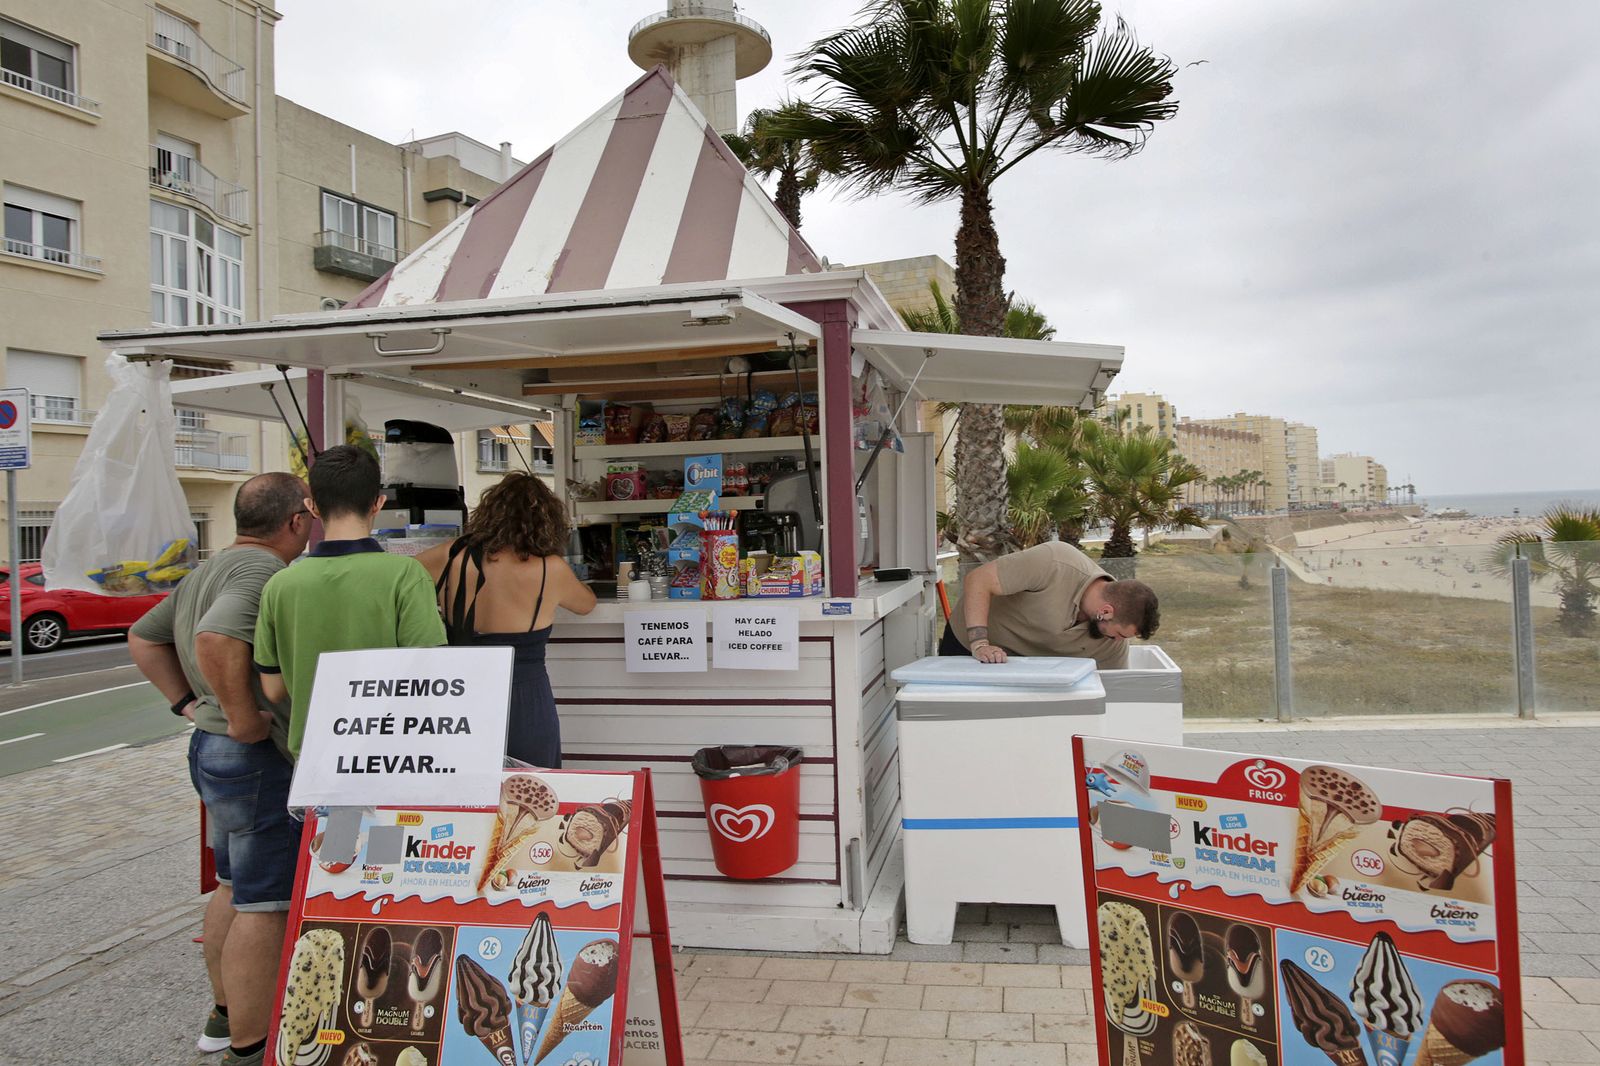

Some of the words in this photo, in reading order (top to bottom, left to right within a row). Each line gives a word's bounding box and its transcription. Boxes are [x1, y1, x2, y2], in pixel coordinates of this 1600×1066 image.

[641, 621, 689, 631] TENEMOS
[735, 617, 752, 625] HAY
[638, 636, 663, 646] CAFÉ
[666, 637, 693, 645] PARA
[750, 643, 783, 651] COFFEE
[642, 652, 689, 661] LLEVAR...
[348, 678, 466, 699] TENEMOS
[333, 712, 395, 736] CAFÉ
[402, 716, 472, 736] PARA
[336, 755, 457, 775] LLEVAR...
[1249, 789, 1284, 802] FRIGO
[1178, 797, 1203, 809] NUEVO
[398, 814, 421, 823] NUEVO
[403, 860, 421, 873] ICE
[424, 861, 470, 875] CREAM
[1195, 847, 1219, 863] ICE
[1220, 851, 1276, 874] CREAM
[1355, 855, 1381, 870] 1,50€
[428, 879, 438, 887] EN
[439, 879, 471, 887] HELADO!
[517, 877, 550, 890] bueno
[579, 879, 613, 893] bueno
[1228, 870, 1240, 880] EN
[1242, 873, 1280, 889] HELADO!
[1342, 888, 1386, 902] bueno
[1430, 904, 1479, 920] bueno
[483, 939, 497, 956] 2€
[1310, 949, 1329, 968] 2€
[1142, 1000, 1166, 1014] NUEVO
[1199, 993, 1236, 1009] MAGNUM
[377, 1009, 410, 1018] MAGNUM
[1199, 1002, 1237, 1018] DOUBLE
[376, 1017, 409, 1026] DOUBLE
[319, 1031, 342, 1042] NUEVO
[624, 1040, 660, 1050] ACER!
